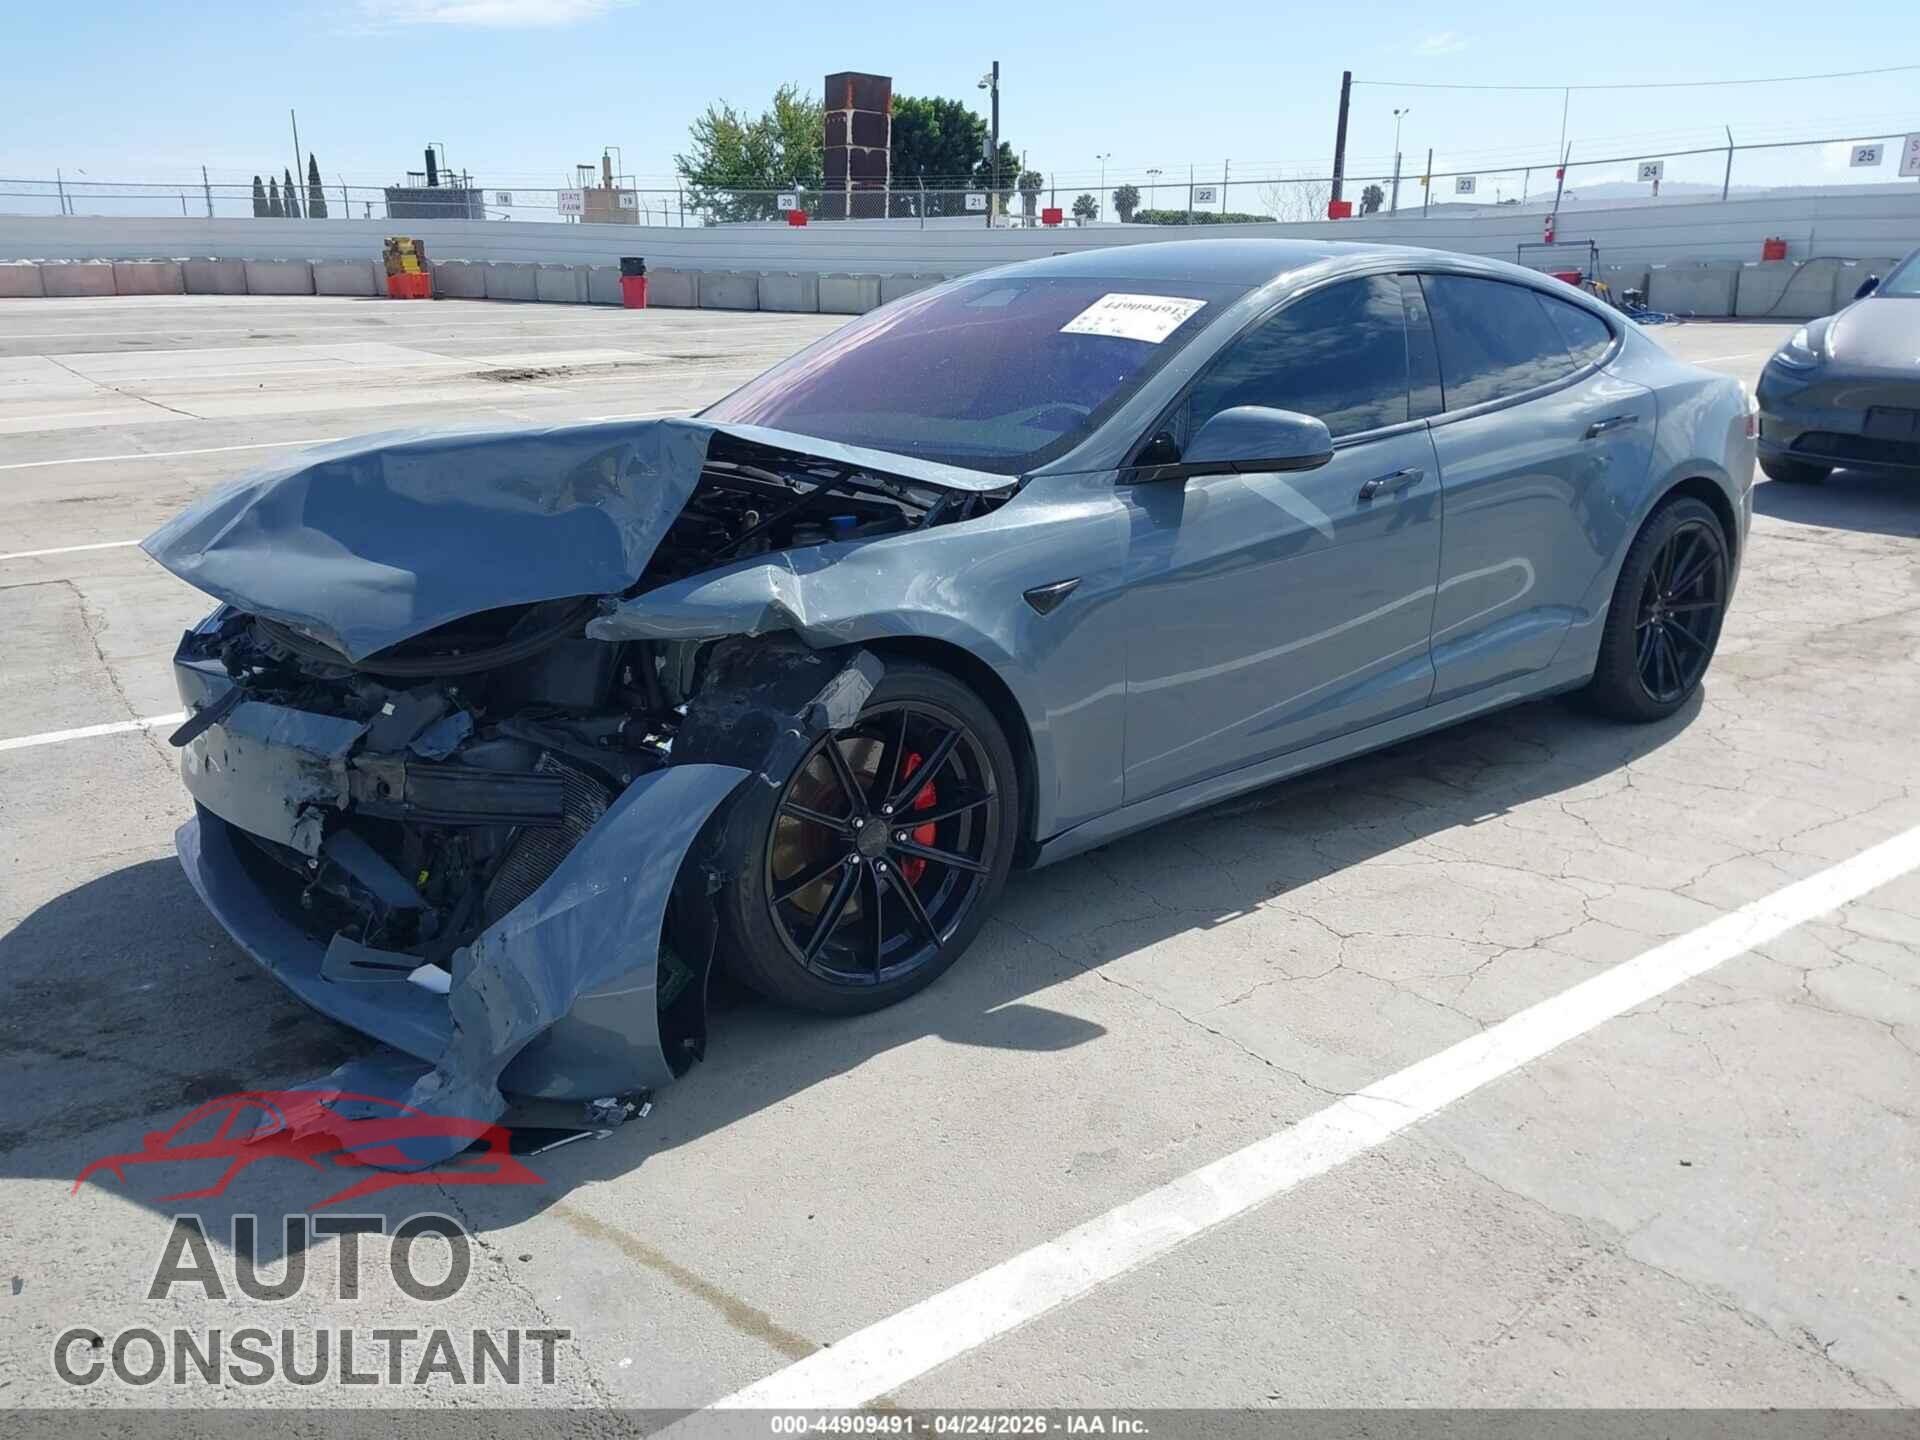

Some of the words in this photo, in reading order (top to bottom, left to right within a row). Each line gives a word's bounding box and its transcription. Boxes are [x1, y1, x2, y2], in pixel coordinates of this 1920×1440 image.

[1857, 149, 1876, 162] 25
[1643, 166, 1658, 177] 24
[1460, 180, 1472, 190] 23
[1199, 191, 1212, 200] 22
[782, 198, 793, 207] 20
[970, 198, 982, 207] 21
